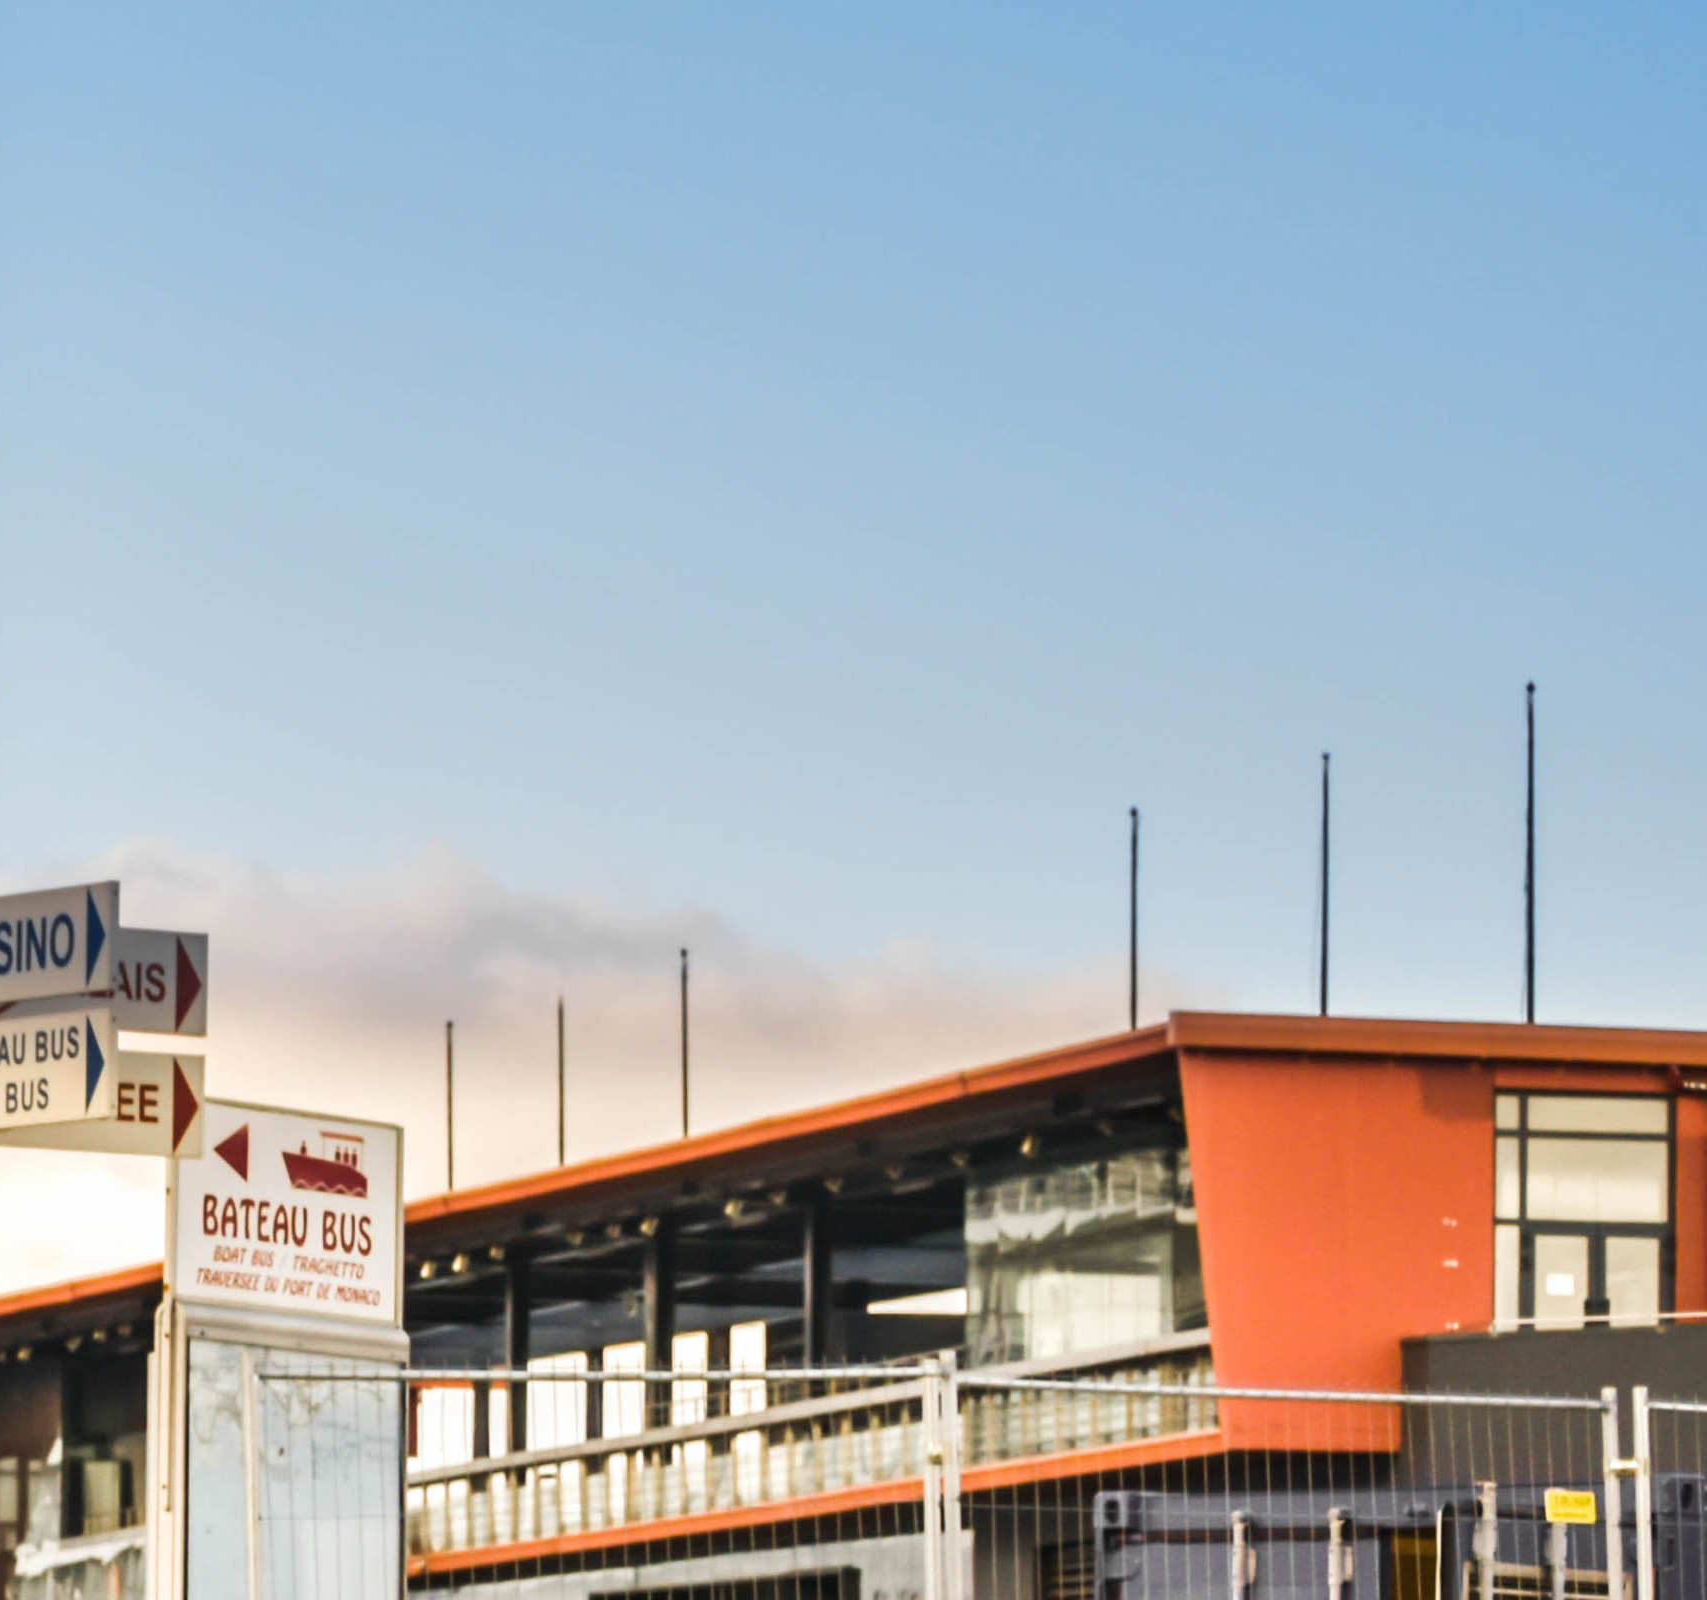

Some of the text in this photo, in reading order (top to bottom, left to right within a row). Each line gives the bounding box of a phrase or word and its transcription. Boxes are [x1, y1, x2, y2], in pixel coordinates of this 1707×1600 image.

[117, 961, 166, 1004] AIS
[35, 1026, 79, 1063] BUS
[5, 1078, 49, 1113] BUS
[117, 1082, 159, 1123] EE
[202, 1193, 372, 1256] BATEAU BUS
[213, 1245, 247, 1265] BOAT
[251, 1250, 274, 1268] BUS
[264, 1275, 280, 1293] DU
[282, 1278, 313, 1297] PORT
[316, 1282, 331, 1300] DE
[336, 1285, 381, 1307] MONACO
